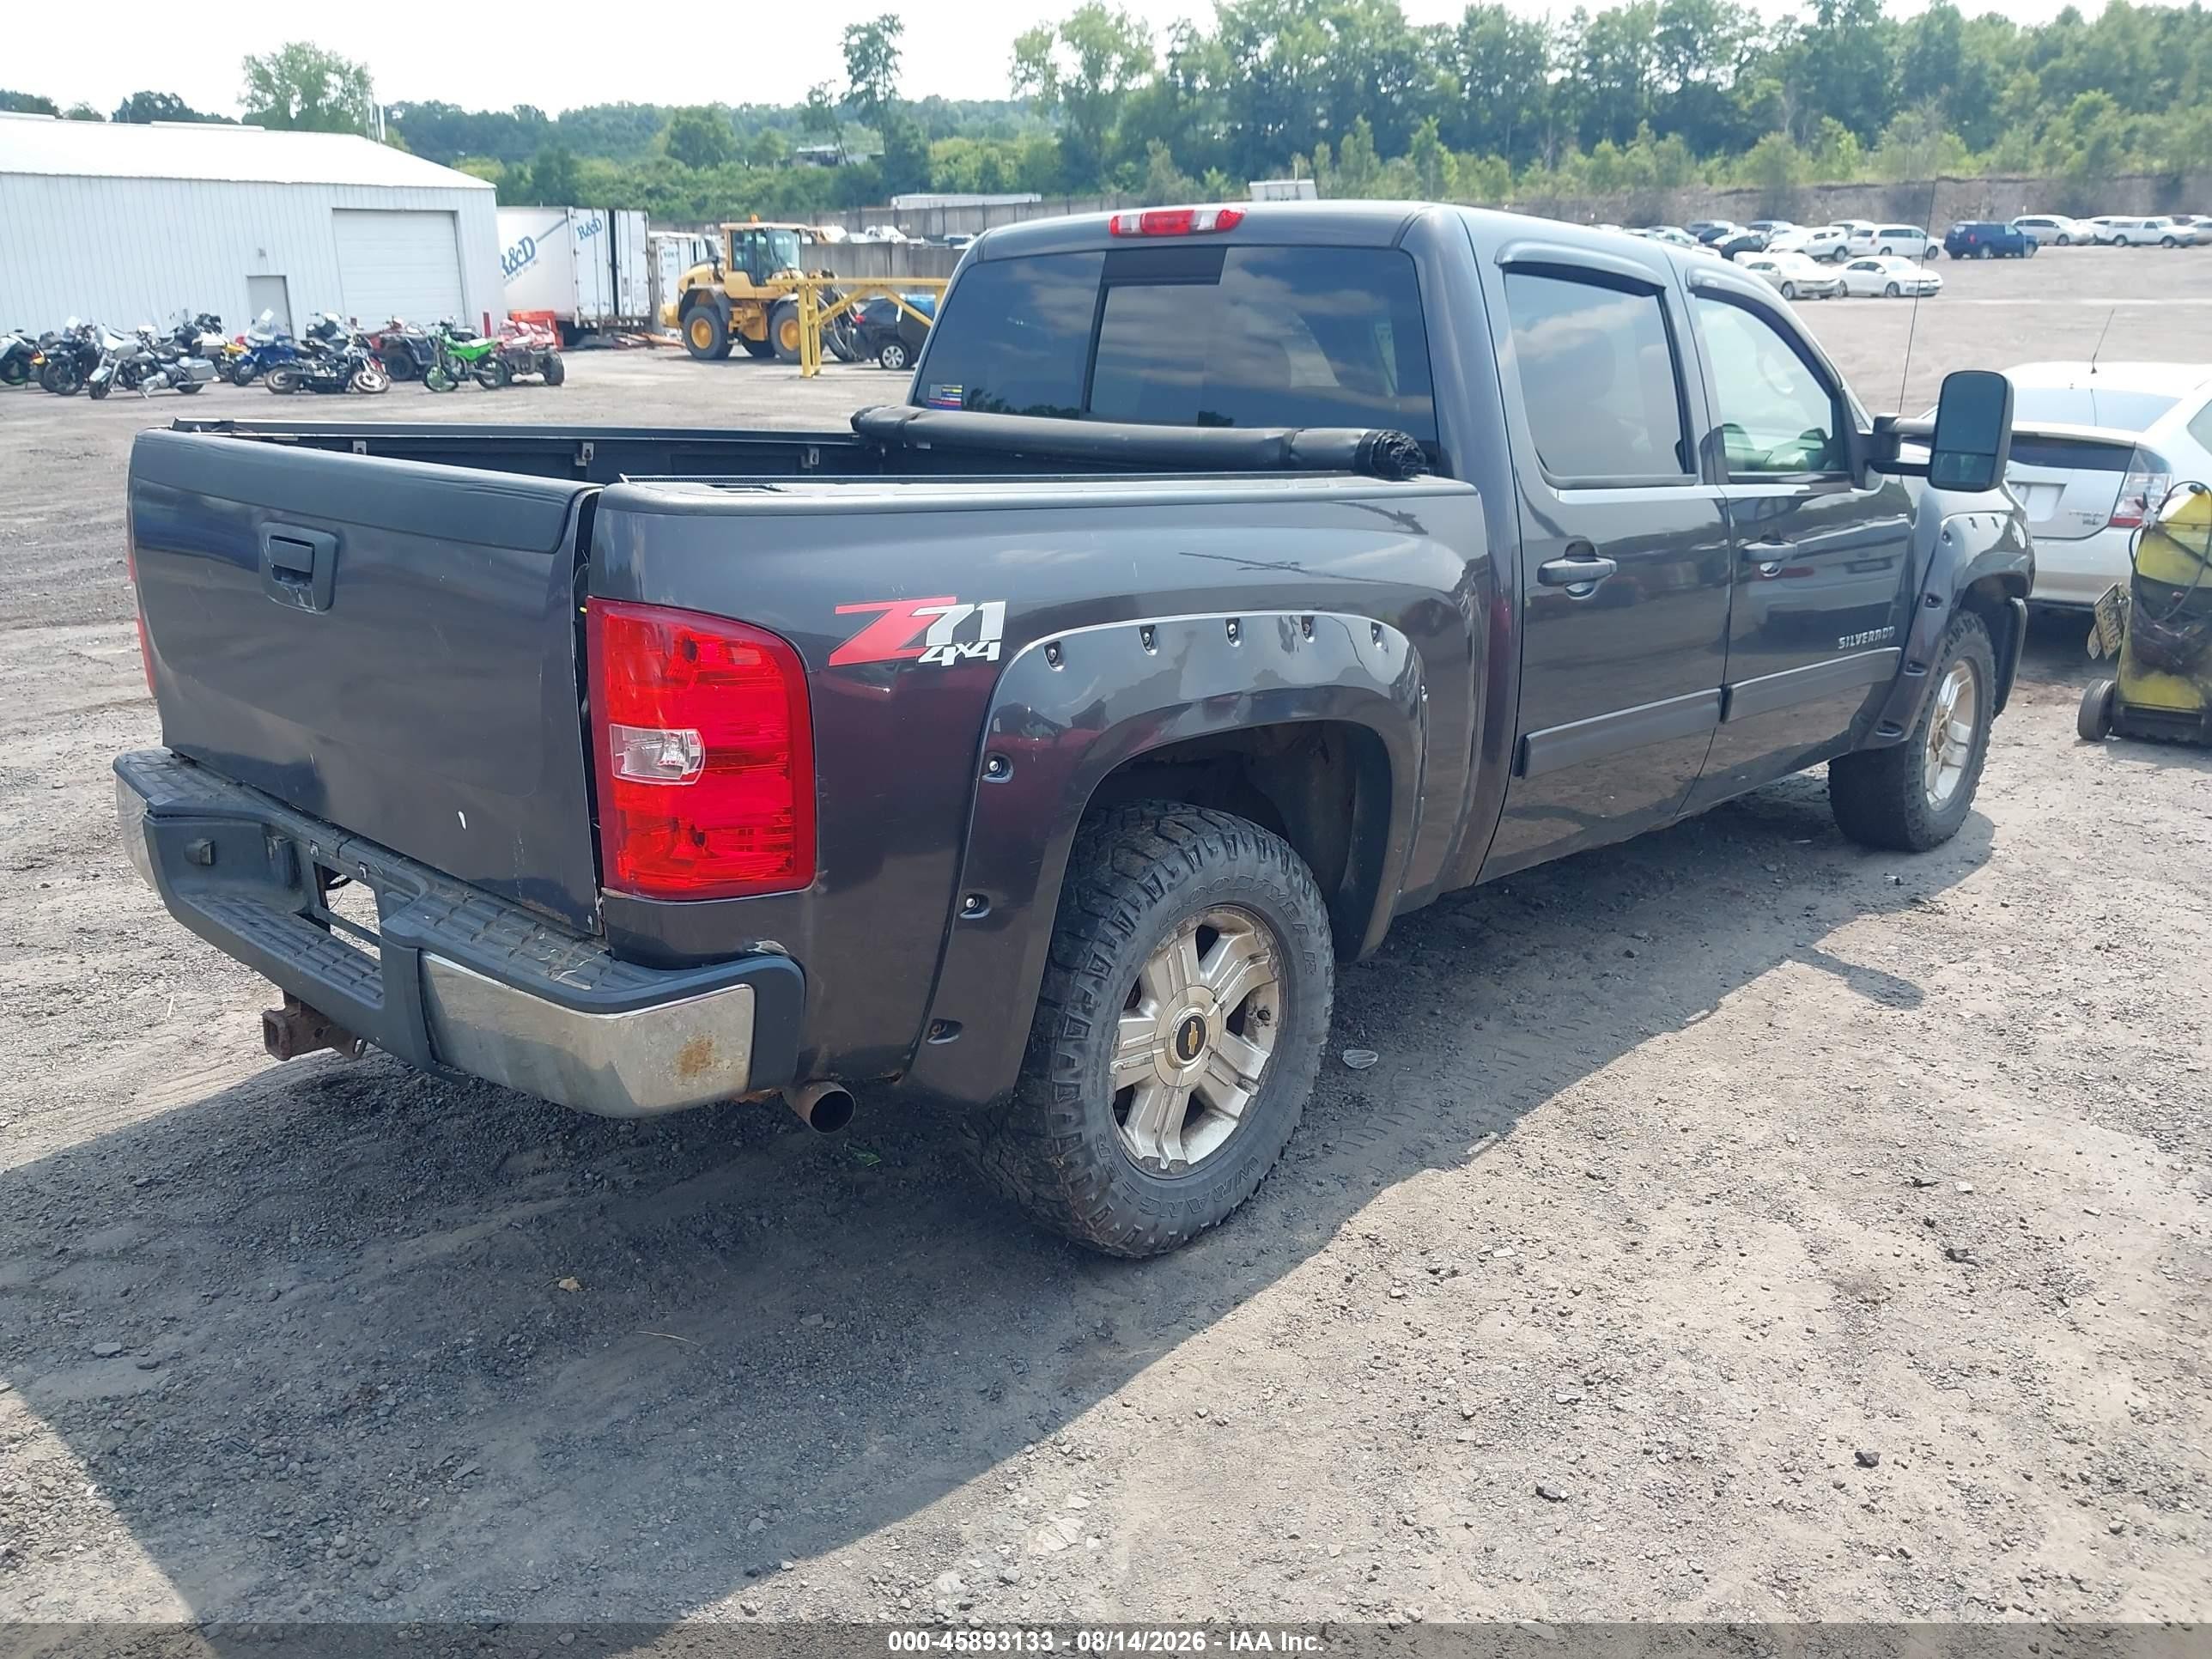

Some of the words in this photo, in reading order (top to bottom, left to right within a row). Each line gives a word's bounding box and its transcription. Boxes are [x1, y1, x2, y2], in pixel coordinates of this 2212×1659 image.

[577, 217, 603, 241] R&D
[828, 595, 1006, 666] Z71
[1838, 625, 1895, 649] SILVERADO
[1159, 873, 1318, 976] GOODYEAR
[1095, 1132, 1260, 1218] WRANGLER
